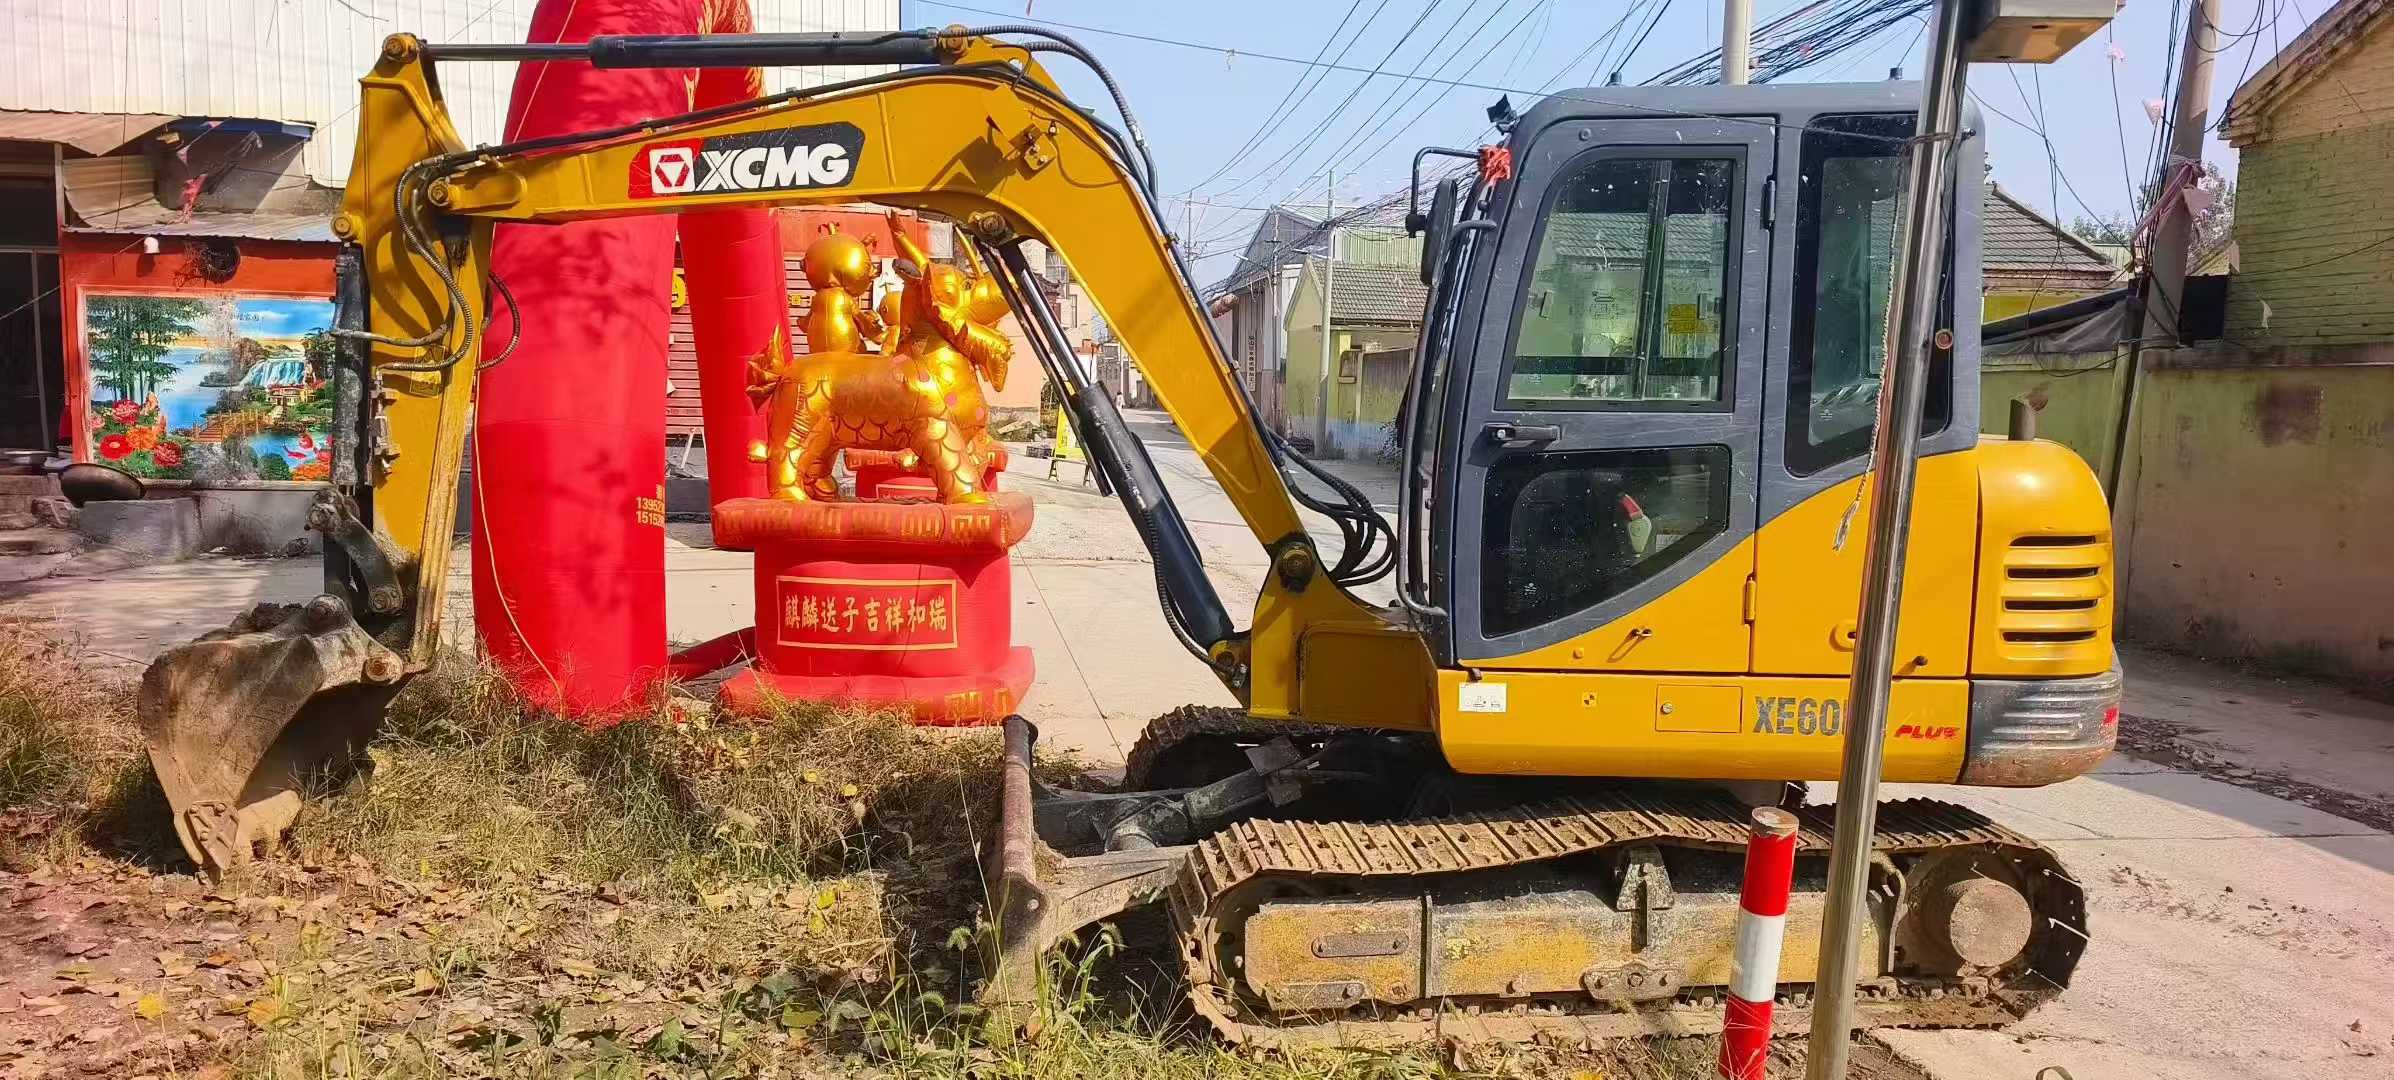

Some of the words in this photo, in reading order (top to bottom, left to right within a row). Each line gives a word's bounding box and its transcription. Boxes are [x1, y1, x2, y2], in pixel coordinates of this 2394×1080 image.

[695, 142, 850, 192] XCMG
[1752, 696, 1848, 736] XE60
[1894, 724, 1960, 739] PLUS
